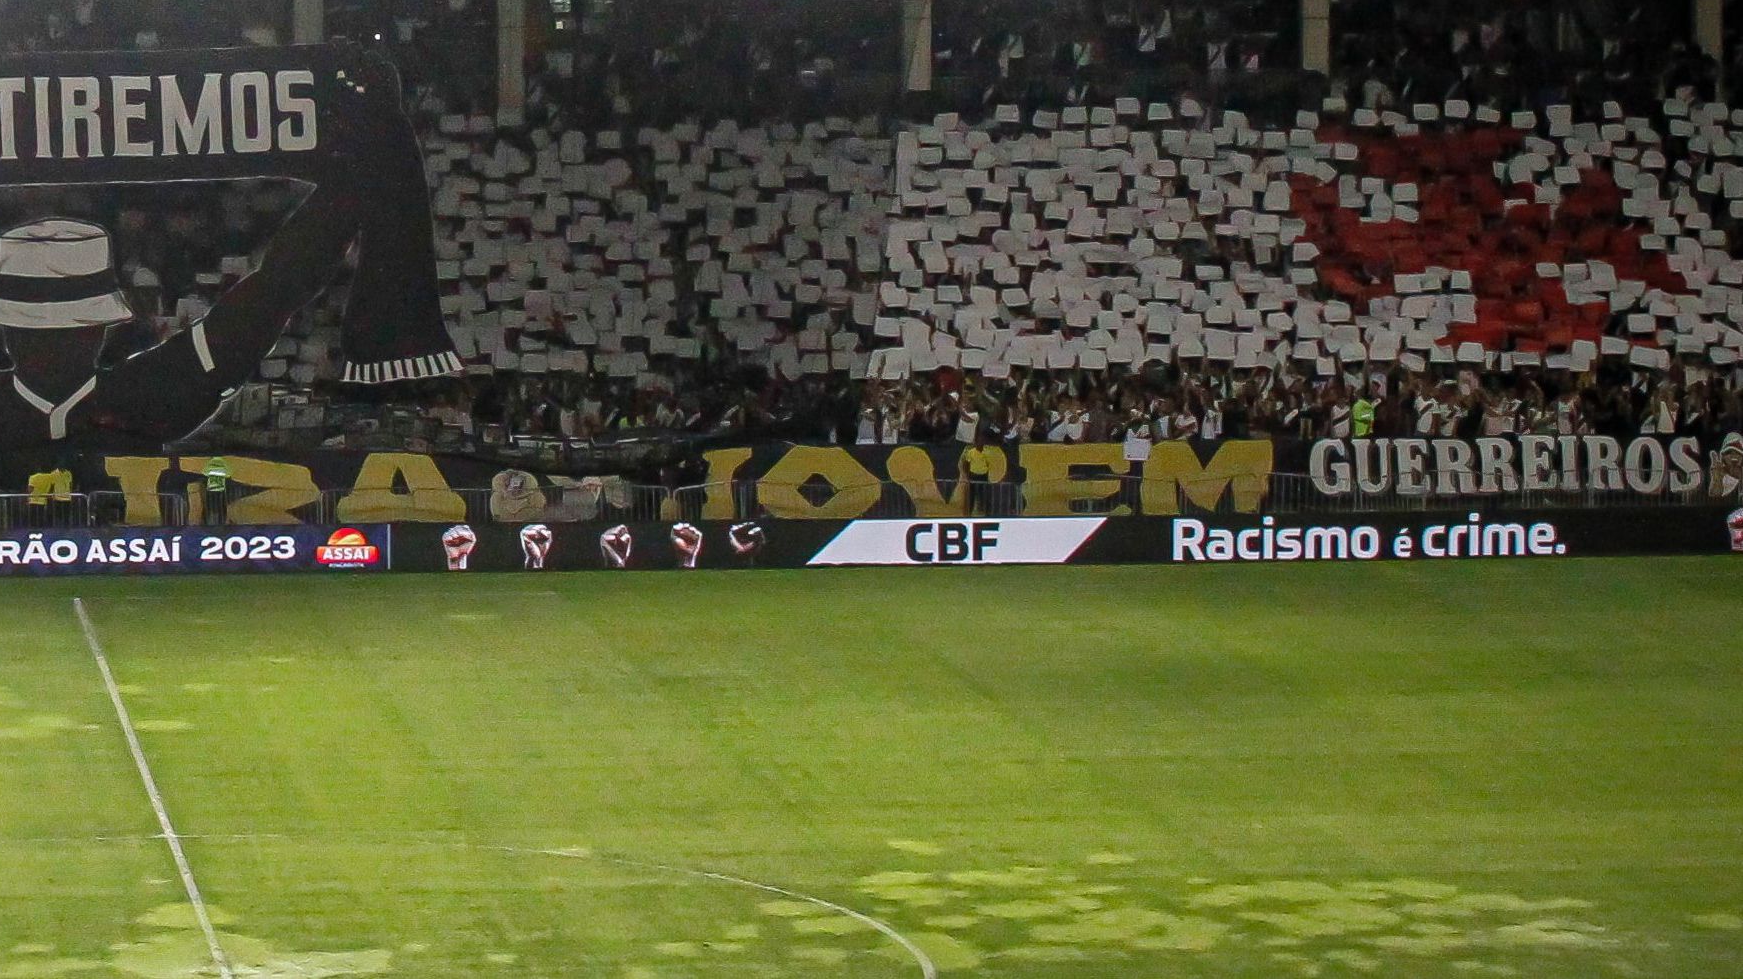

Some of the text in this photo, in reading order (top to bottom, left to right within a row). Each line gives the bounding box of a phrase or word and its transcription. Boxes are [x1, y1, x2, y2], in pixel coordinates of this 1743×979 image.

[1308, 433, 1702, 495] GUERREIROS
[200, 536, 296, 561] 2023
[905, 523, 1000, 563] CBF
[1172, 513, 1567, 561] Racismo é crime.
